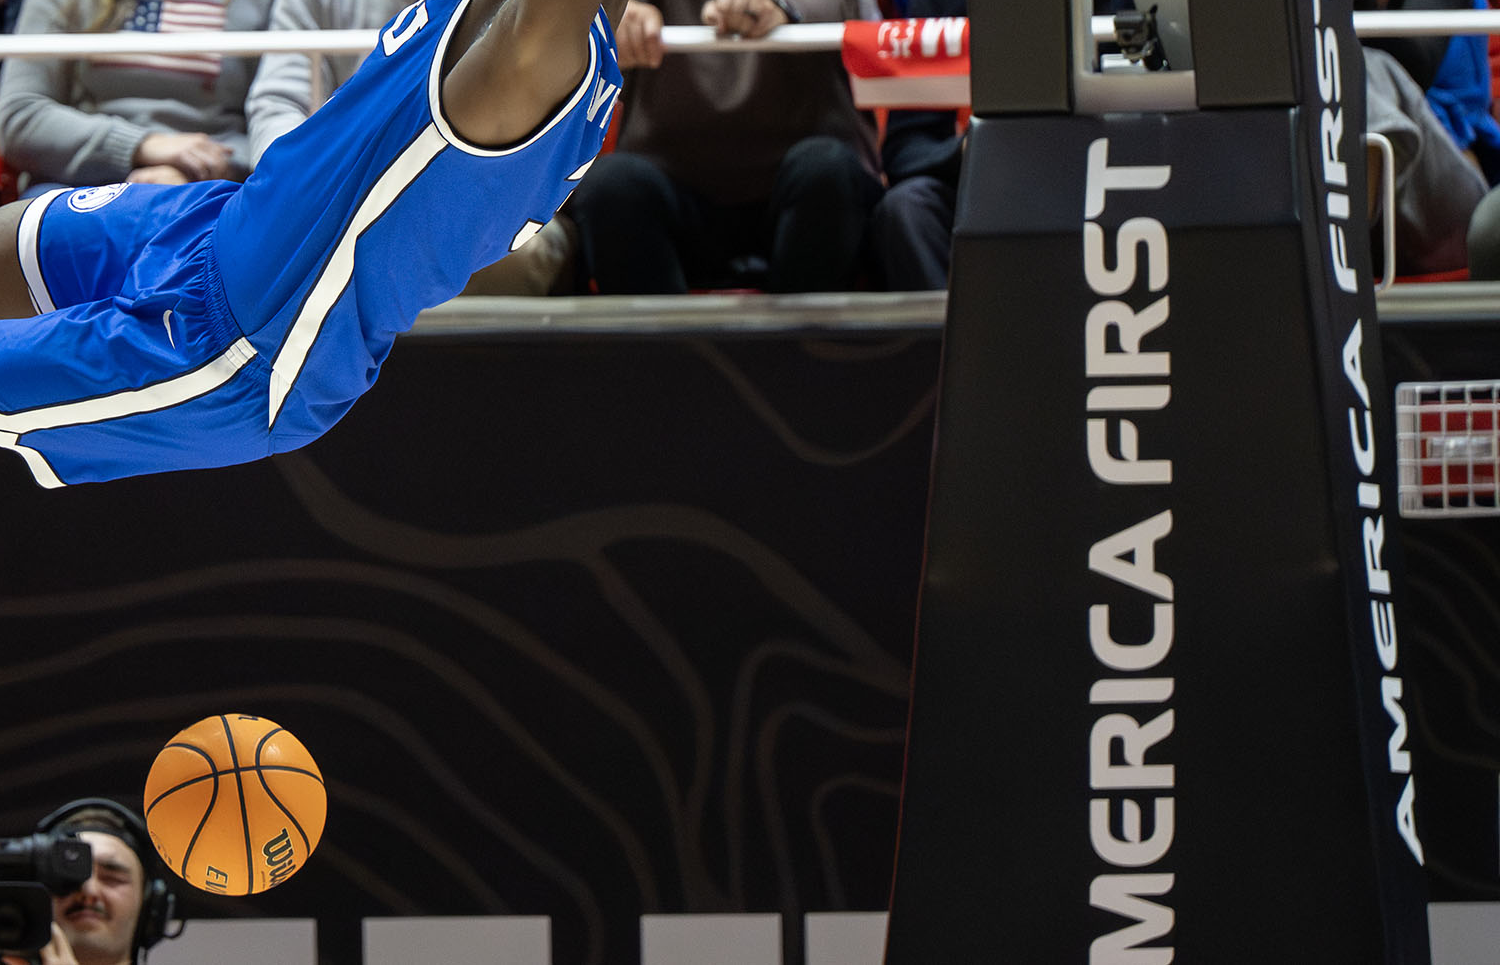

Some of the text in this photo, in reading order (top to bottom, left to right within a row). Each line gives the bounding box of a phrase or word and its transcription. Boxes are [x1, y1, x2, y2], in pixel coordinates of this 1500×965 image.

[1084, 137, 1175, 965] MERICA FIRST
[1342, 317, 1425, 867] AMERICA
